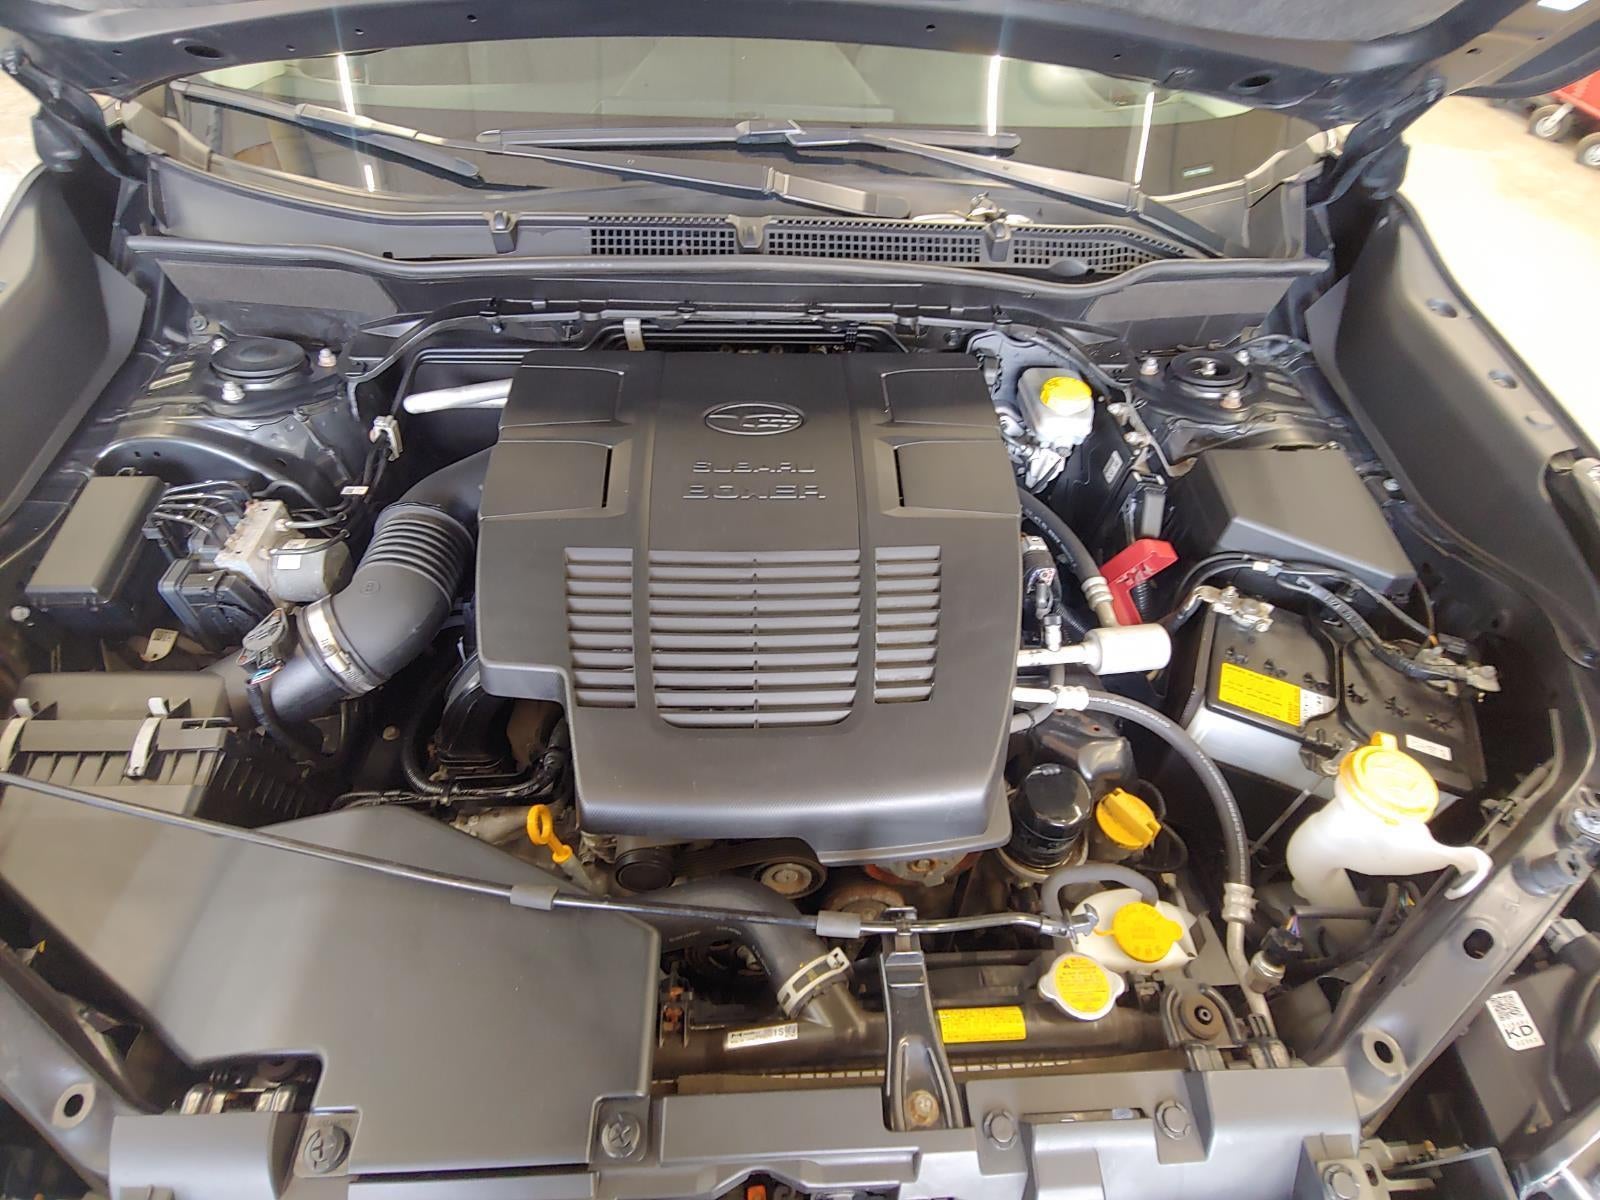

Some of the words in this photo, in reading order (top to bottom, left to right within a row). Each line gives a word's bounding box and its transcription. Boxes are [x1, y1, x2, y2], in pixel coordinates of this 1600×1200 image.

[692, 460, 816, 473] SUBARU
[682, 484, 827, 499] BOXER
[1504, 1024, 1535, 1040] KD
